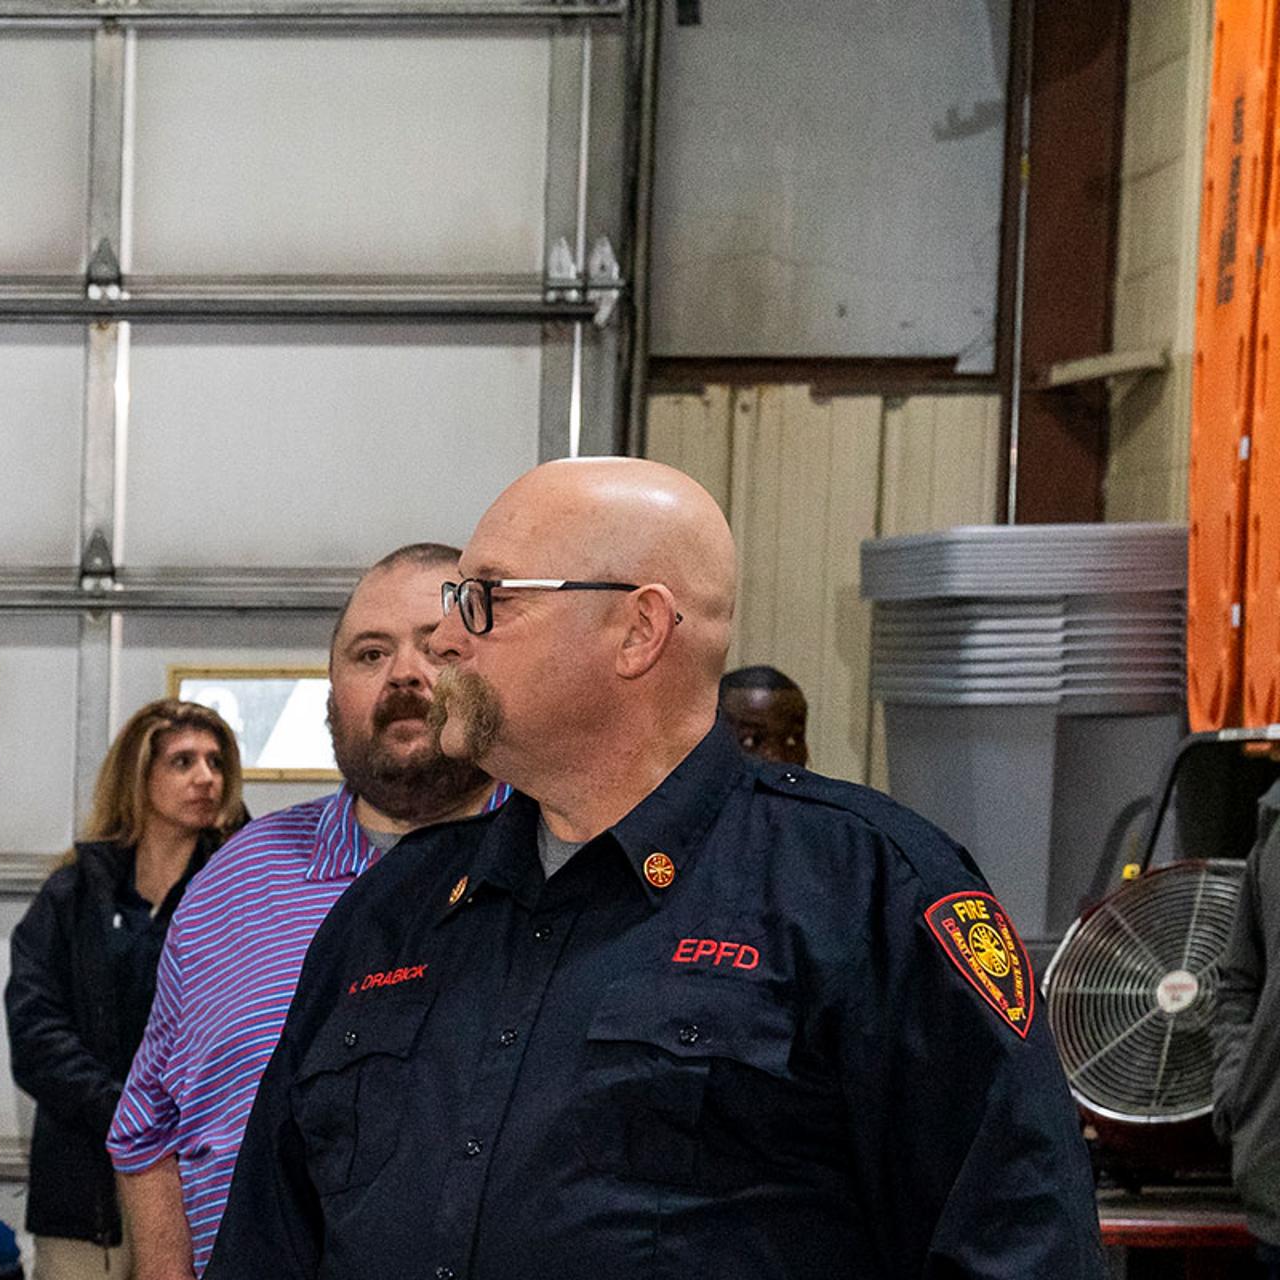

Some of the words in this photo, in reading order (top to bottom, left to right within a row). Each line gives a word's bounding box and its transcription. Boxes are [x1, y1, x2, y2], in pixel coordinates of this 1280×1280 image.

[952, 899, 991, 923] FIRE
[672, 938, 760, 970] EPFD
[360, 964, 429, 991] DRABICK
